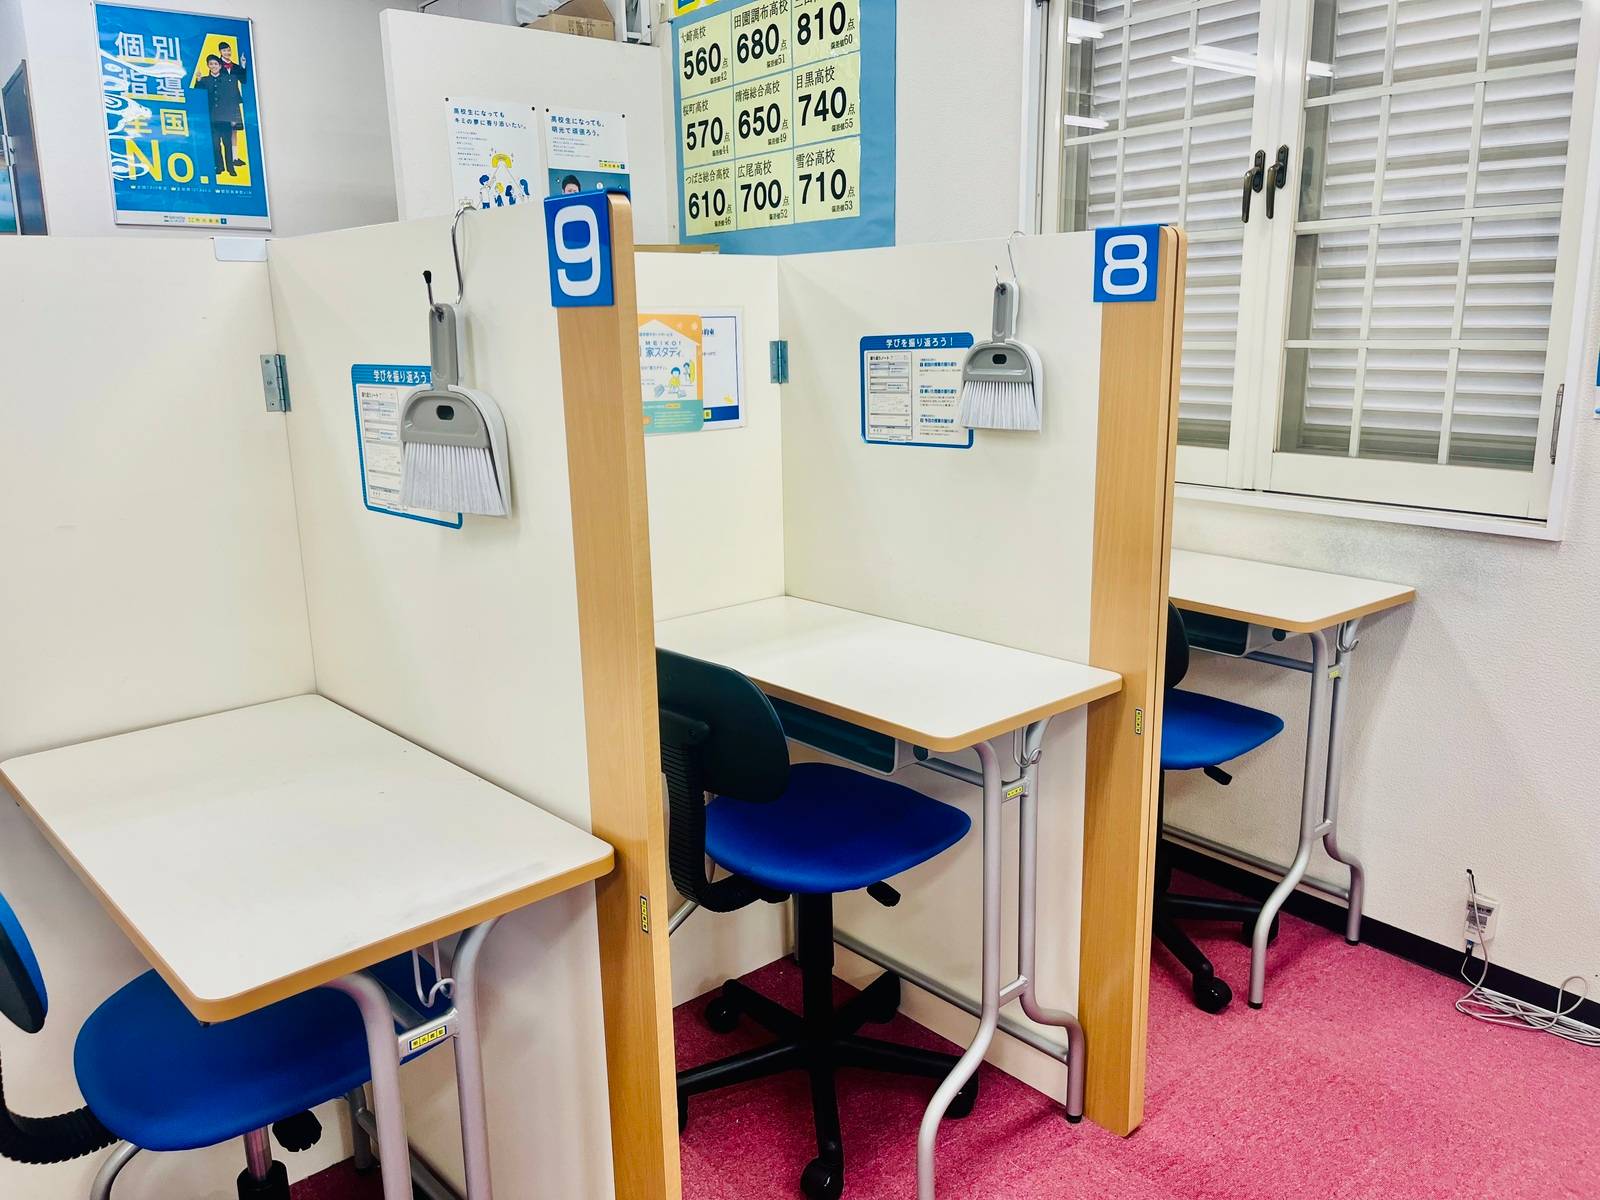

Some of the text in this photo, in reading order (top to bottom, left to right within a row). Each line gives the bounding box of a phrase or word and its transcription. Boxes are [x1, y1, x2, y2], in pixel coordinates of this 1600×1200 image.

[734, 0, 788, 29] 田園調布高校
[115, 32, 182, 62] 個別
[796, 66, 835, 90] 目黒高校
[453, 108, 505, 118] 高校生になっても
[737, 160, 772, 178] 広尾高校
[796, 148, 835, 168] 雪谷高校
[685, 168, 730, 184] つばさ総合高校
[554, 205, 601, 297] 9
[1102, 234, 1148, 295] 8
[886, 336, 953, 348] 学びを振り返ろう！
